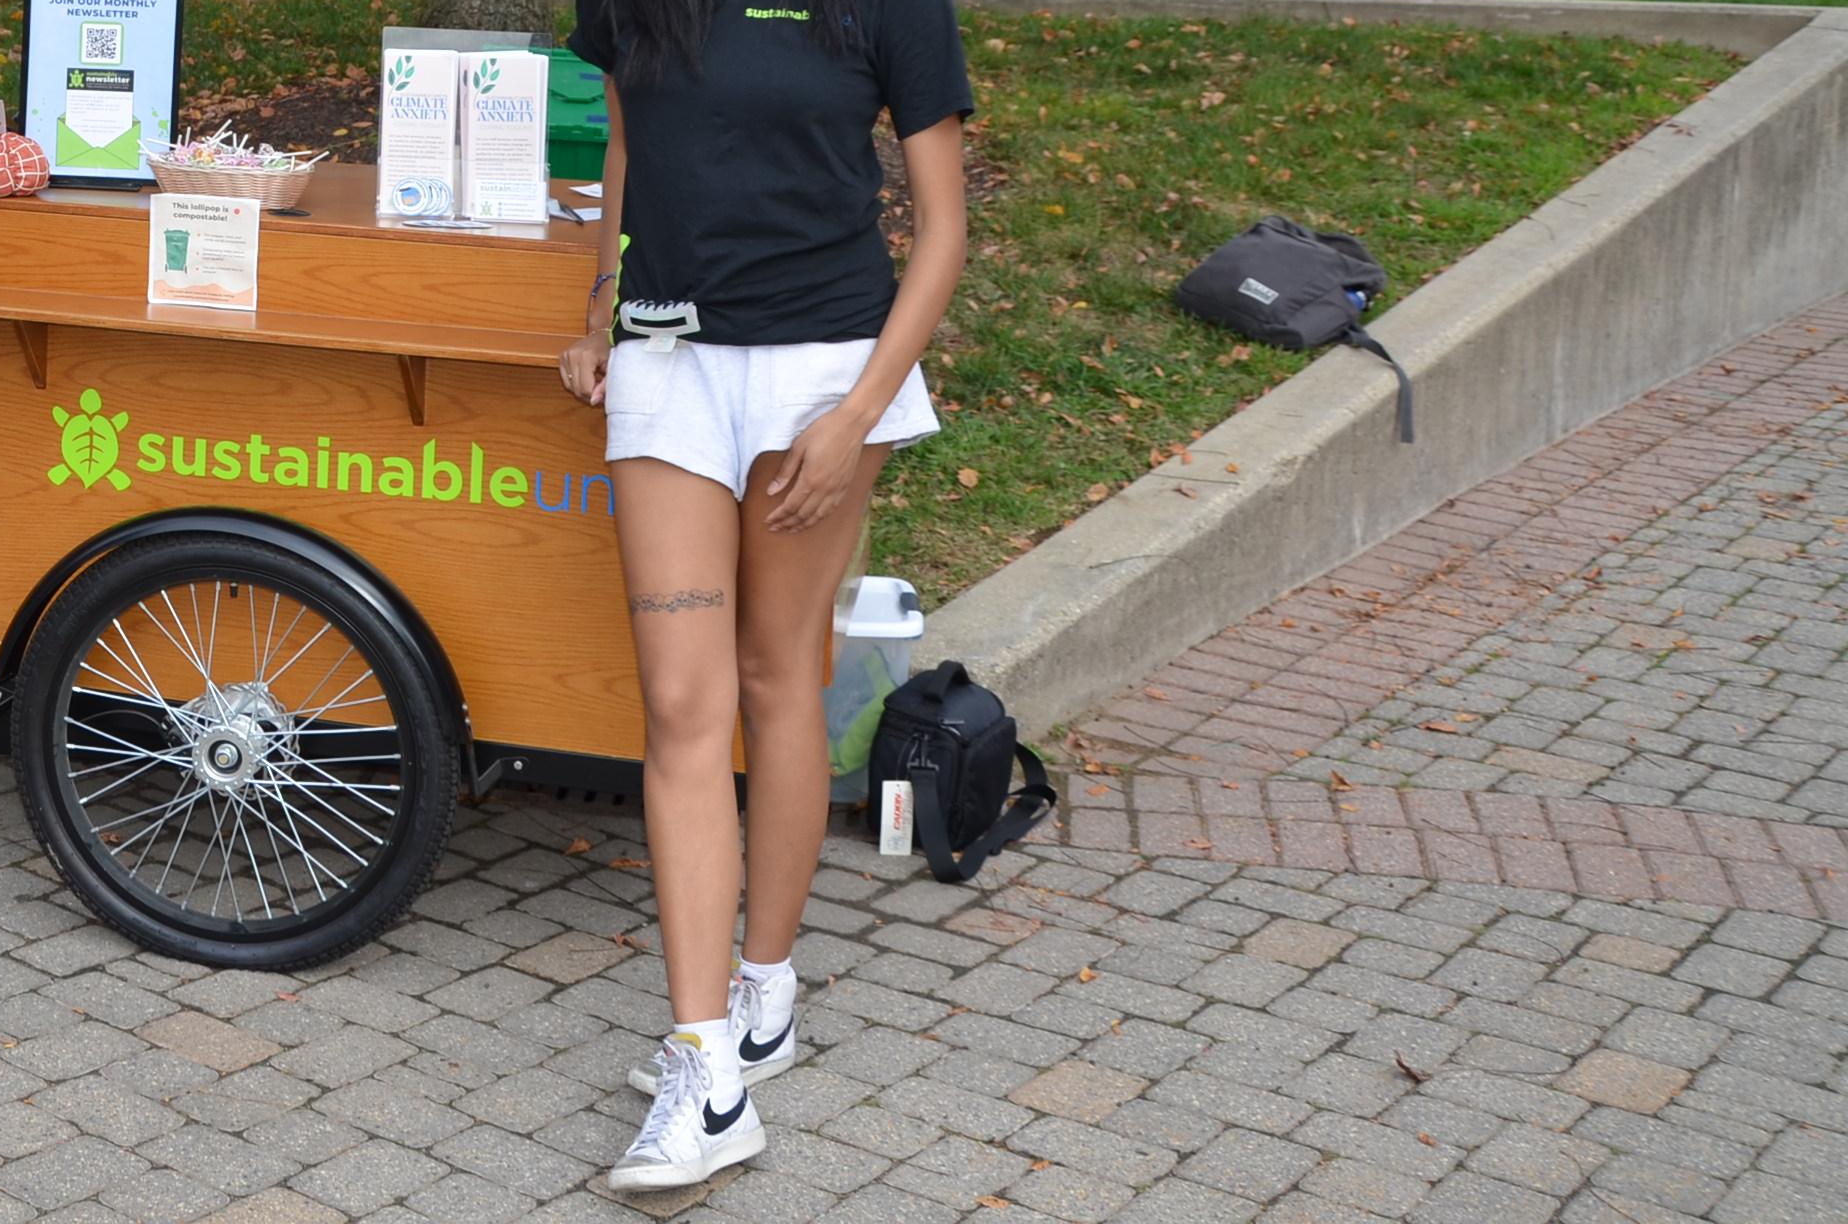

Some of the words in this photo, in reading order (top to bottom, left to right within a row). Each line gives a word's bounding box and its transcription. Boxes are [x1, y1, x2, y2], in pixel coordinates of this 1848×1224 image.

[67, 8, 139, 19] NEWSLETTER
[745, 7, 811, 21] sustainab
[390, 97, 447, 109] CLIMATE
[476, 99, 534, 112] CLIMATE
[391, 108, 449, 121] ANXIETY
[477, 111, 535, 123] ANXIETY
[172, 202, 189, 210] This
[190, 203, 221, 213] lollipop
[173, 212, 228, 222] compostable!
